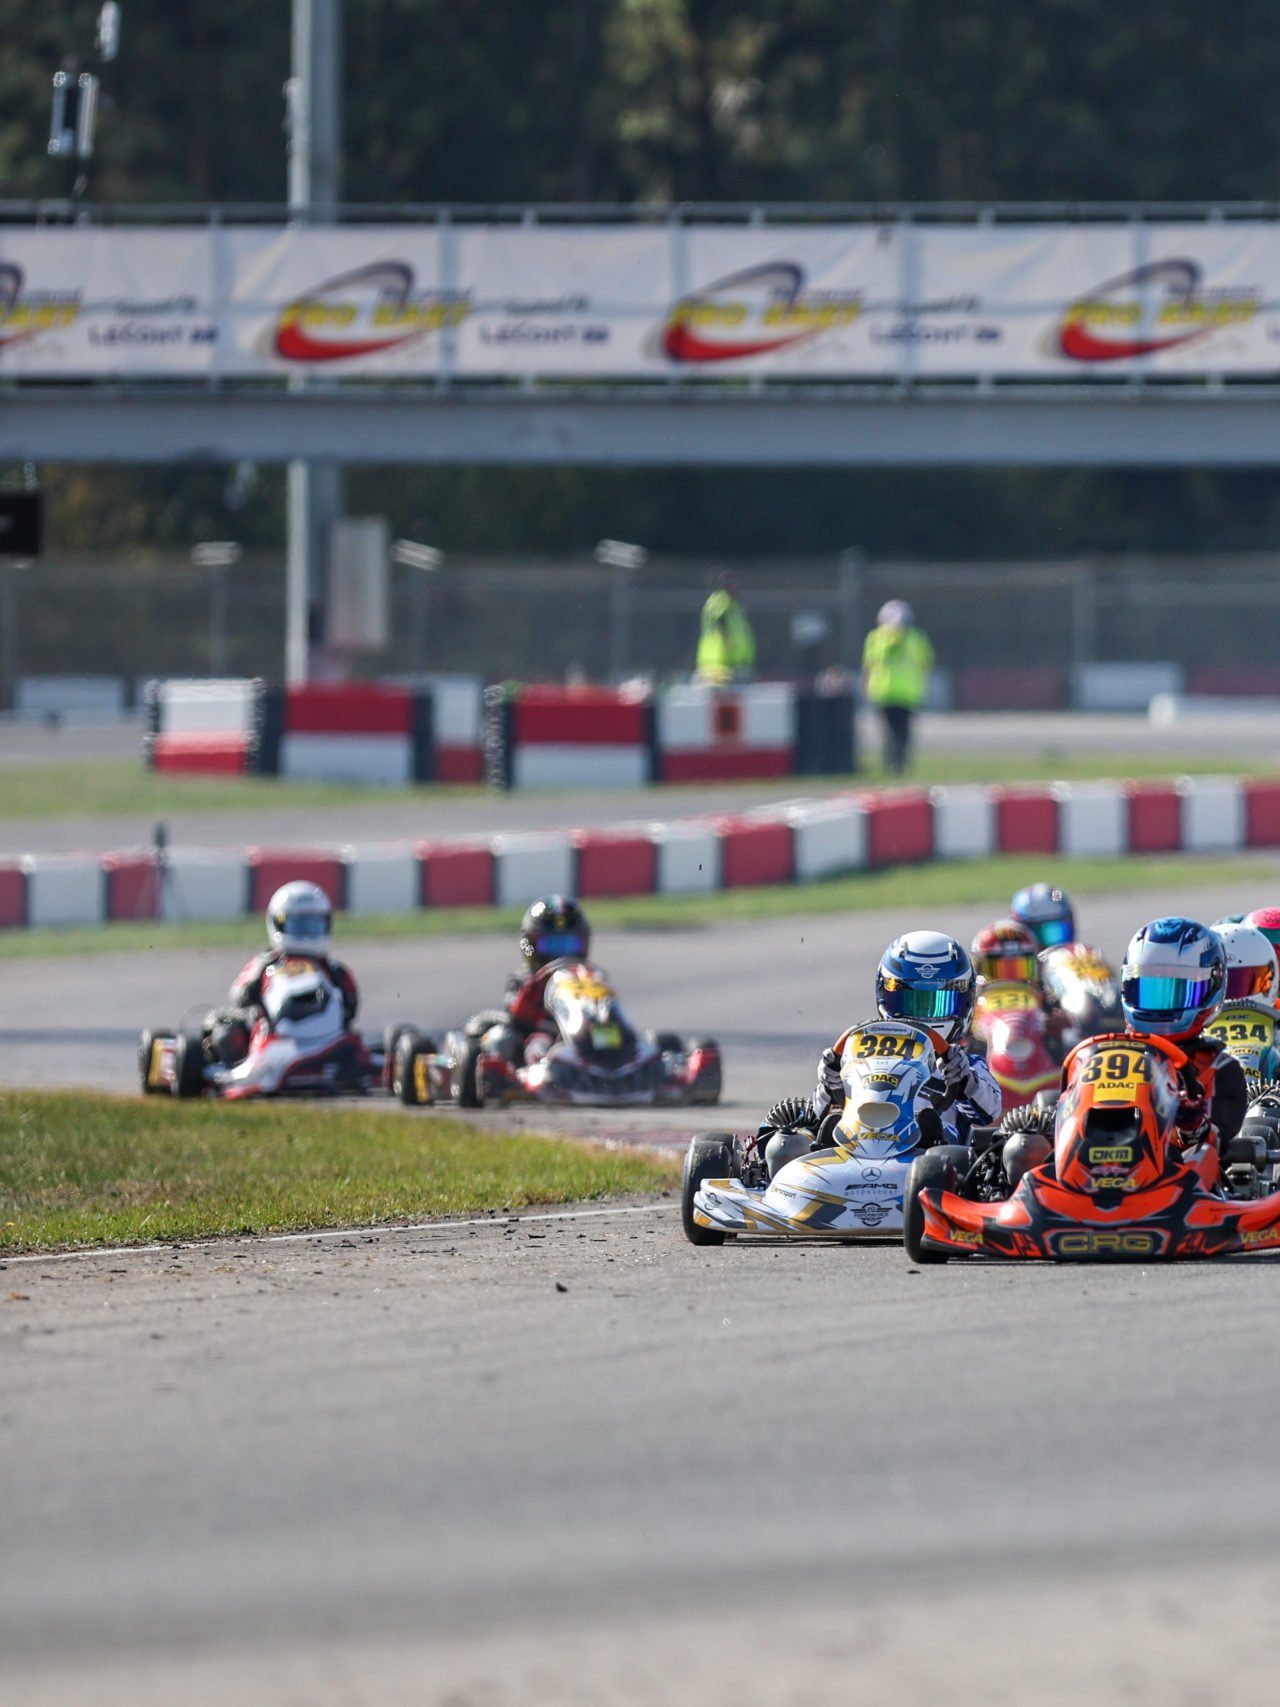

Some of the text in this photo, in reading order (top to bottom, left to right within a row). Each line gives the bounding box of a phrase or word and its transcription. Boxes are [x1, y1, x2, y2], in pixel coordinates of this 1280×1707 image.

[1209, 1024, 1268, 1043] 334
[857, 1035, 916, 1060] 384
[1081, 1054, 1153, 1083] 394
[1093, 1150, 1128, 1160] DKM
[1090, 1178, 1136, 1188] VEGA
[949, 1229, 984, 1244] VEGA
[1058, 1234, 1153, 1253] CRG
[1240, 1229, 1280, 1244] VEGA
